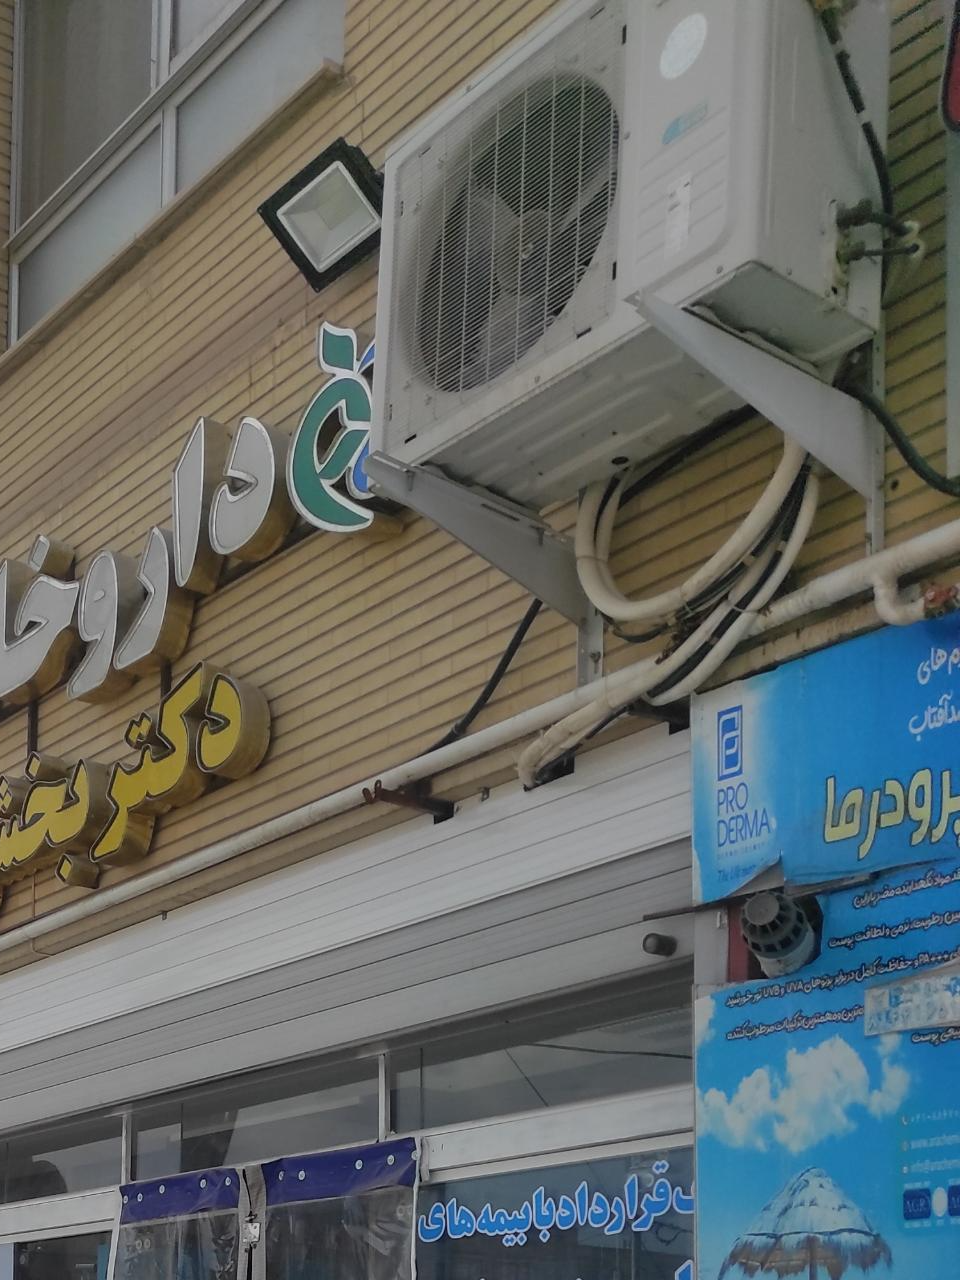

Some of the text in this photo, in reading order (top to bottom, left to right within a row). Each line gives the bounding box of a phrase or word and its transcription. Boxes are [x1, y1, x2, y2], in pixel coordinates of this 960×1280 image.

[89, 660, 246, 864] دکتر
[717, 781, 748, 818] PRO
[717, 807, 771, 848] DERMA
[418, 1197, 476, 1243] های
[532, 1185, 555, 1243] با
[555, 1160, 673, 1235] قرارداد
[476, 1201, 533, 1247] بیمه
